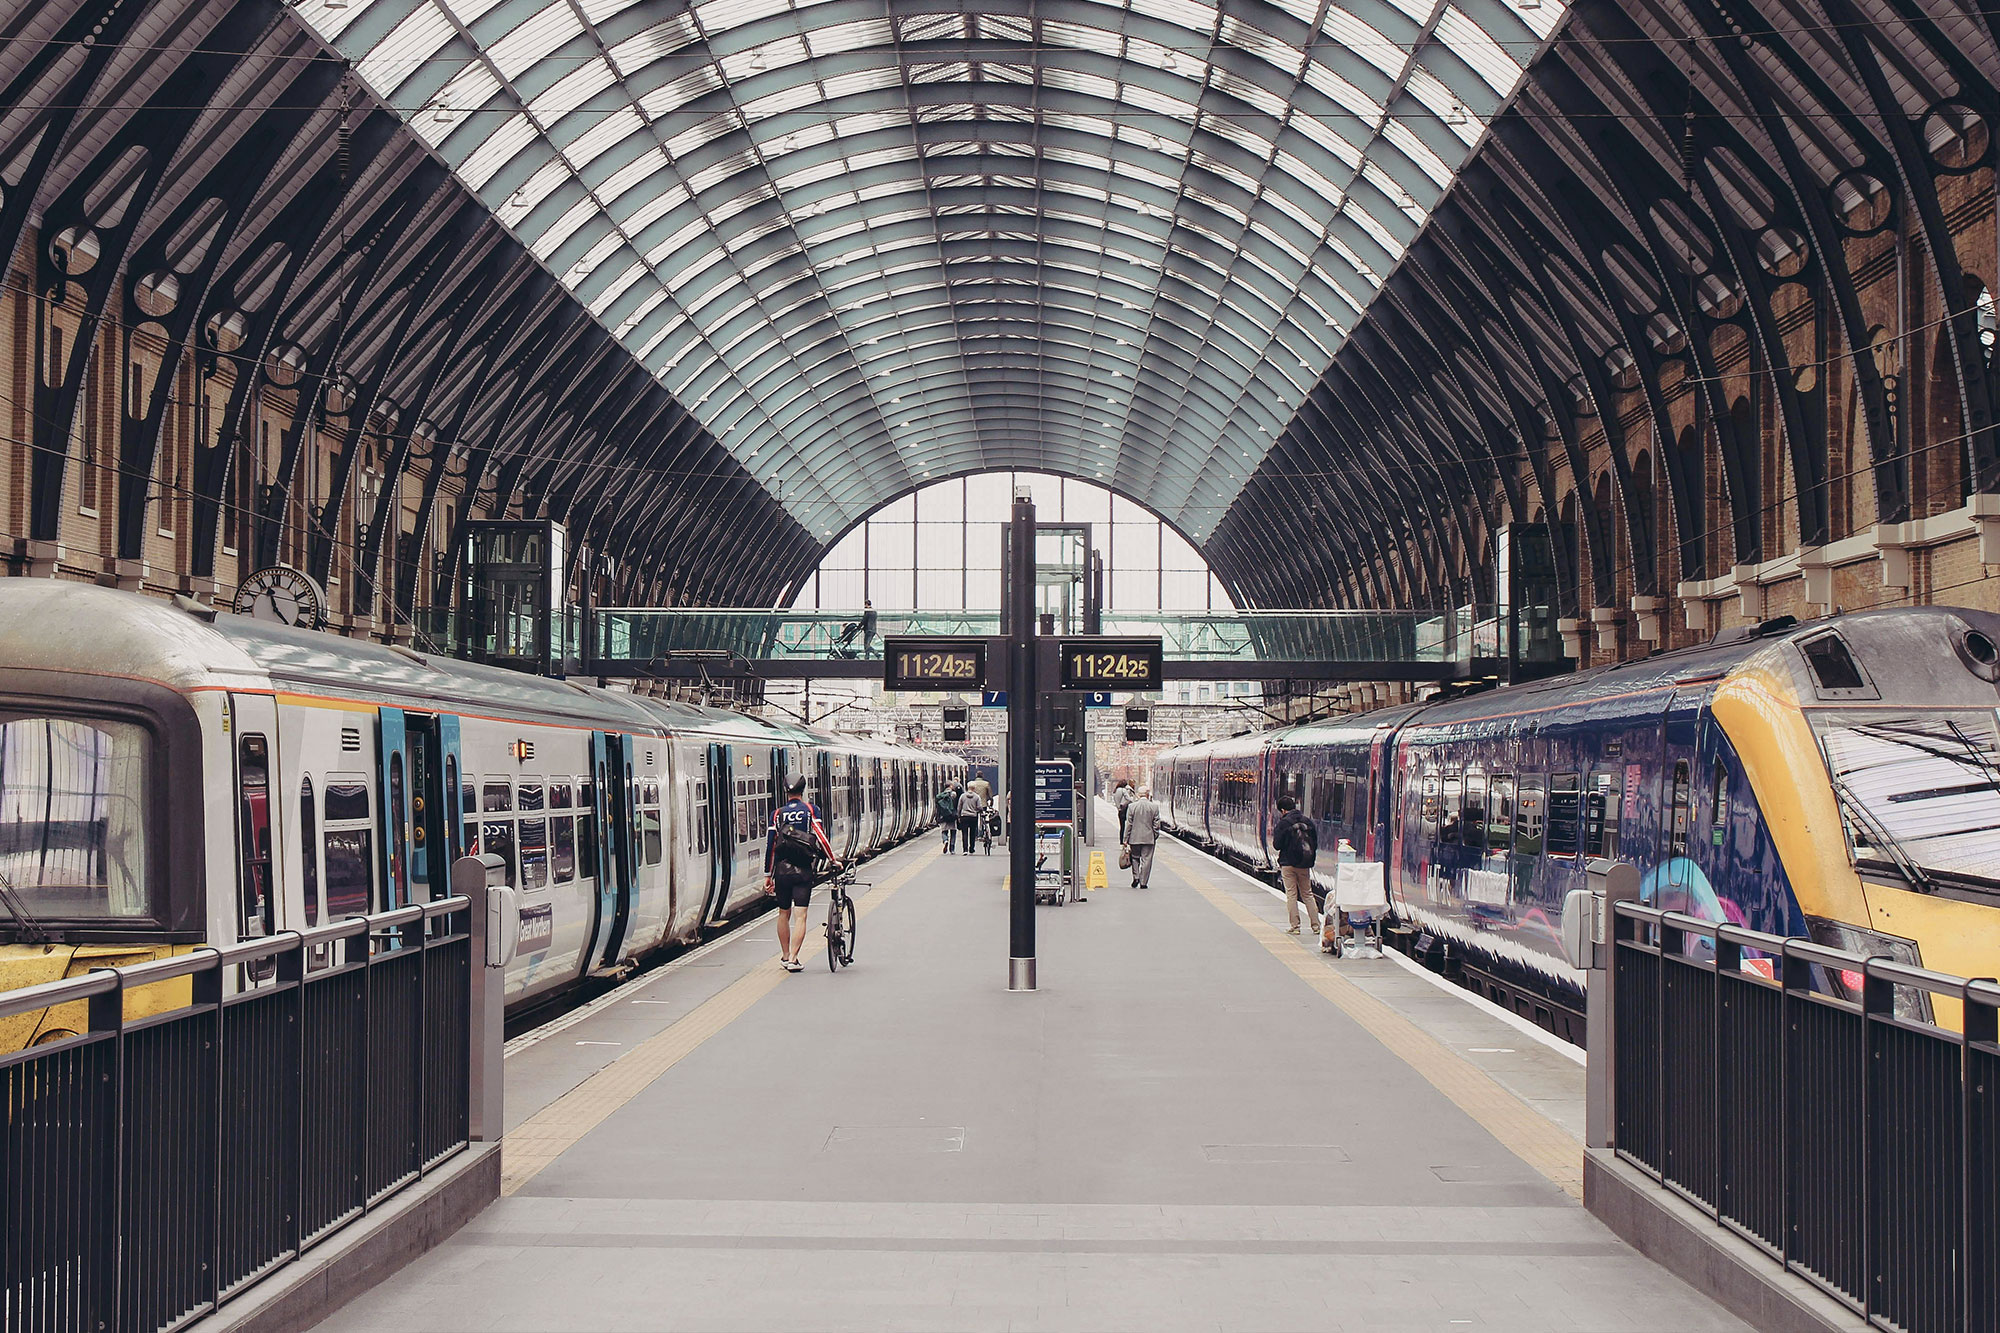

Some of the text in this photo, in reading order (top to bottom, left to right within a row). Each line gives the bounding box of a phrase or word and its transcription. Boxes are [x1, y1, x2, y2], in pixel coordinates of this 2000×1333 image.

[989, 691, 999, 703] 7
[1093, 691, 1103, 703] 6
[782, 810, 804, 822] TCC
[520, 915, 551, 943] Great Northern
